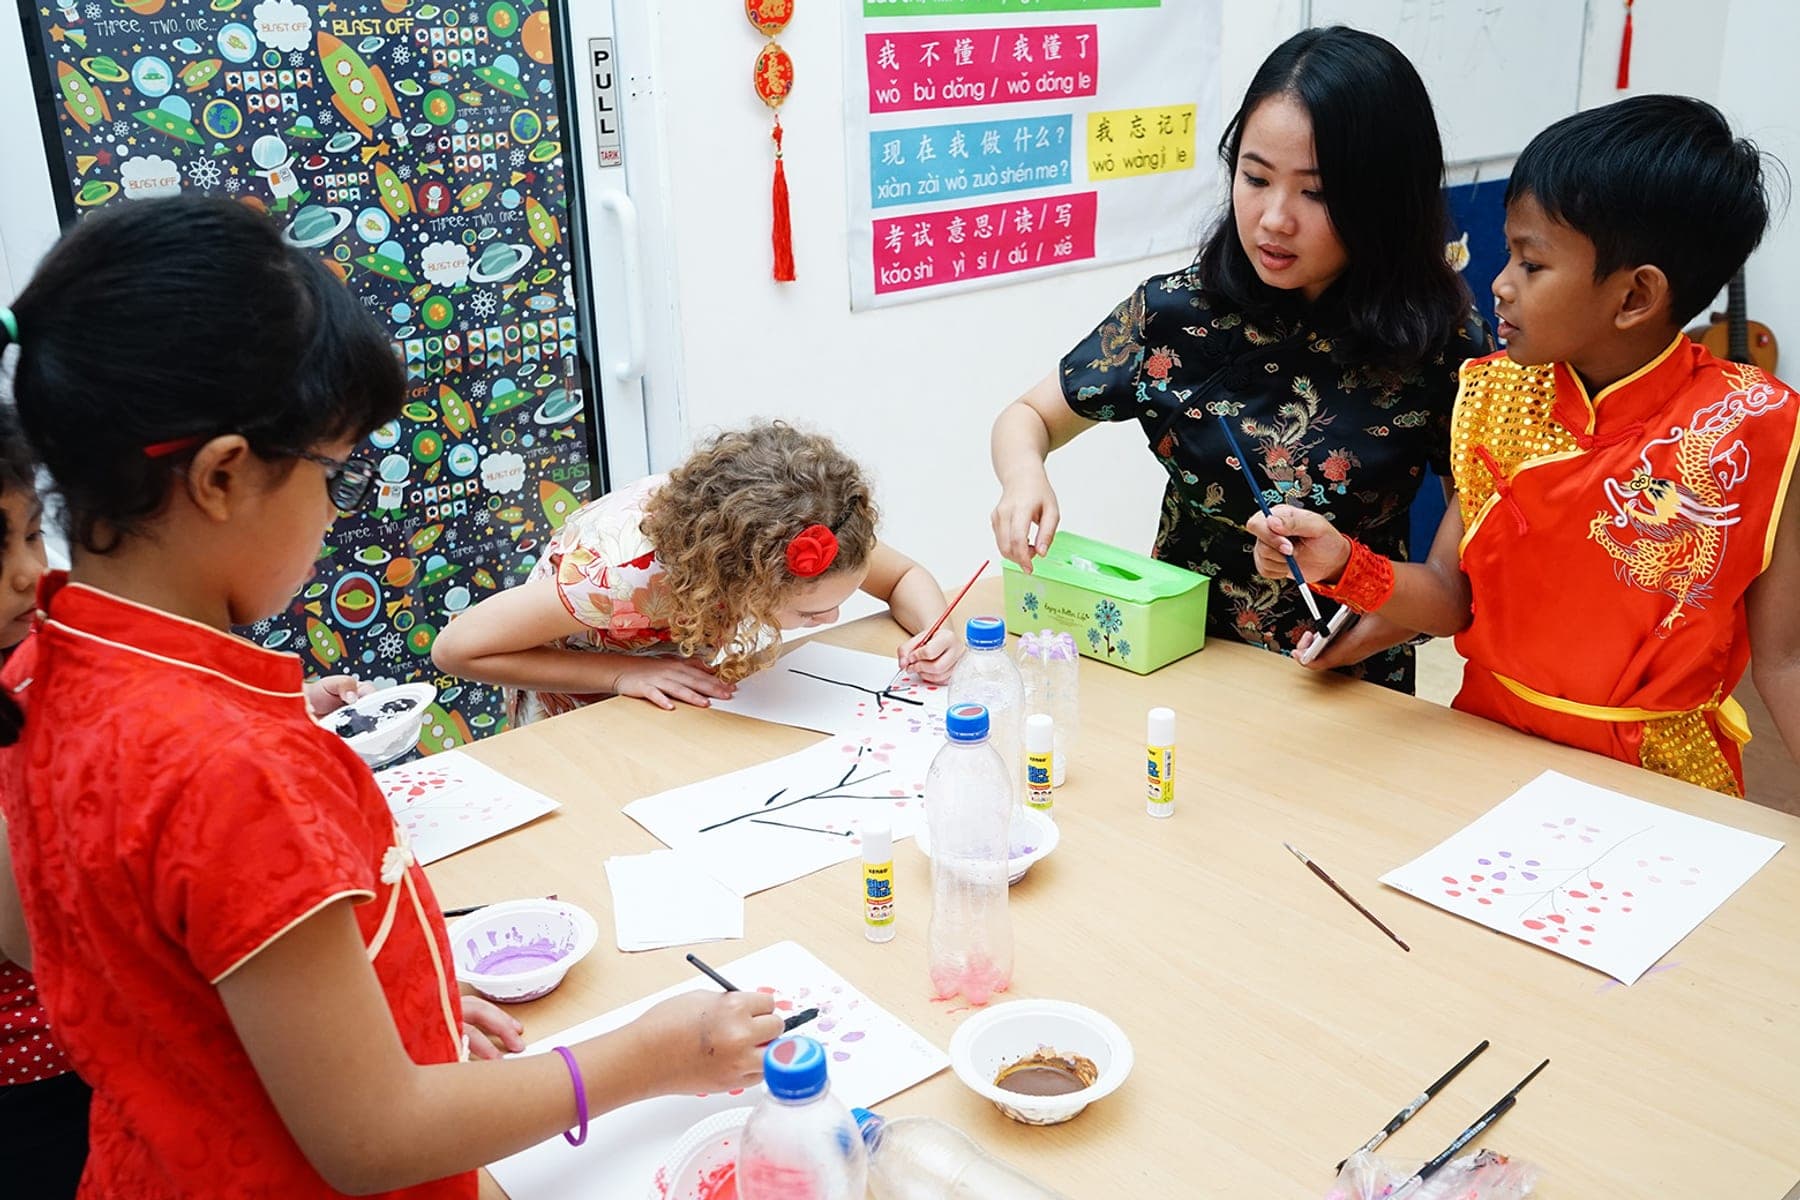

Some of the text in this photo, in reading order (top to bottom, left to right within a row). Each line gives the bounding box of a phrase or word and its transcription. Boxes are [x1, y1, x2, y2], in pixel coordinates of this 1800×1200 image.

[332, 18, 415, 36] BLAST OFF
[594, 50, 615, 134] PULL
[913, 77, 935, 101] bù
[1077, 71, 1091, 89] le
[877, 176, 912, 200] xiàn
[917, 171, 940, 195] zài
[972, 164, 999, 188] zuò
[1008, 241, 1028, 265] dú
